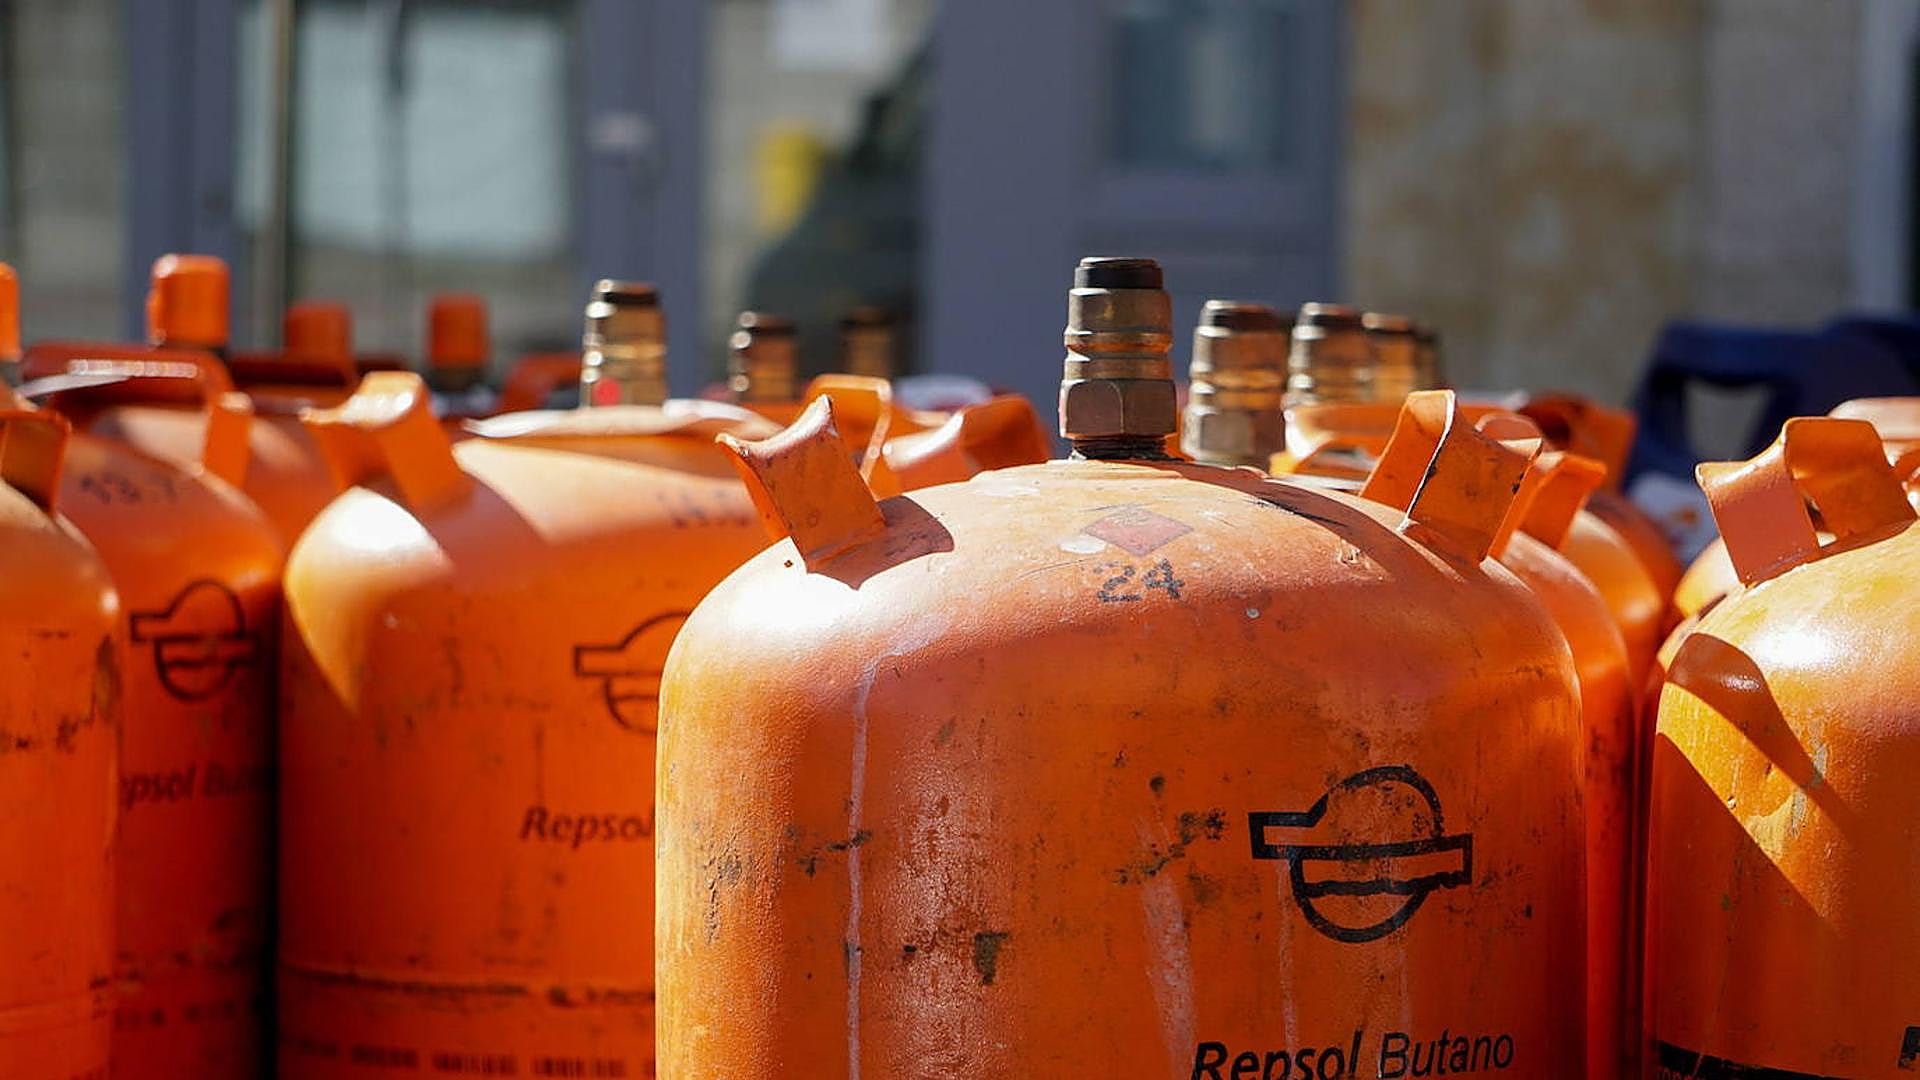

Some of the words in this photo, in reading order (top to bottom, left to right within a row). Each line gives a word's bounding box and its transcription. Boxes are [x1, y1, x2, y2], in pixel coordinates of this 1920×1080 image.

[1094, 558, 1186, 602] 24
[1191, 1029, 1363, 1080] Repsol
[1377, 1028, 1515, 1080] Butano
